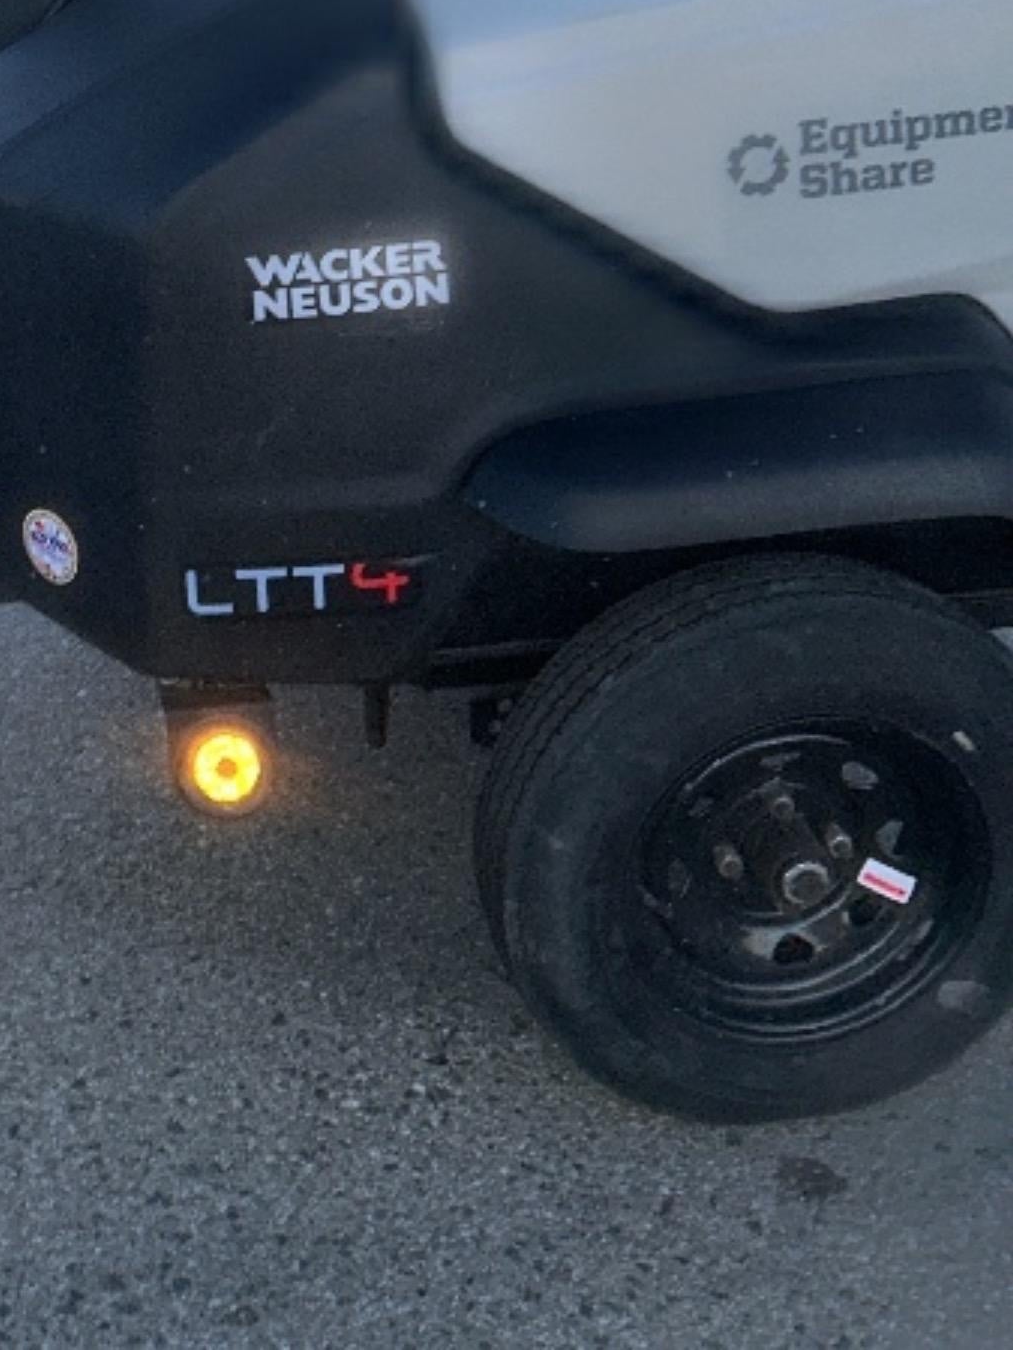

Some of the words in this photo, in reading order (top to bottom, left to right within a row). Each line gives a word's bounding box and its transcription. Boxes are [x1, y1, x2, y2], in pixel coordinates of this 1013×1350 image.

[799, 157, 936, 199] Share
[244, 239, 447, 287] WACKER
[252, 272, 450, 322] NEUSON
